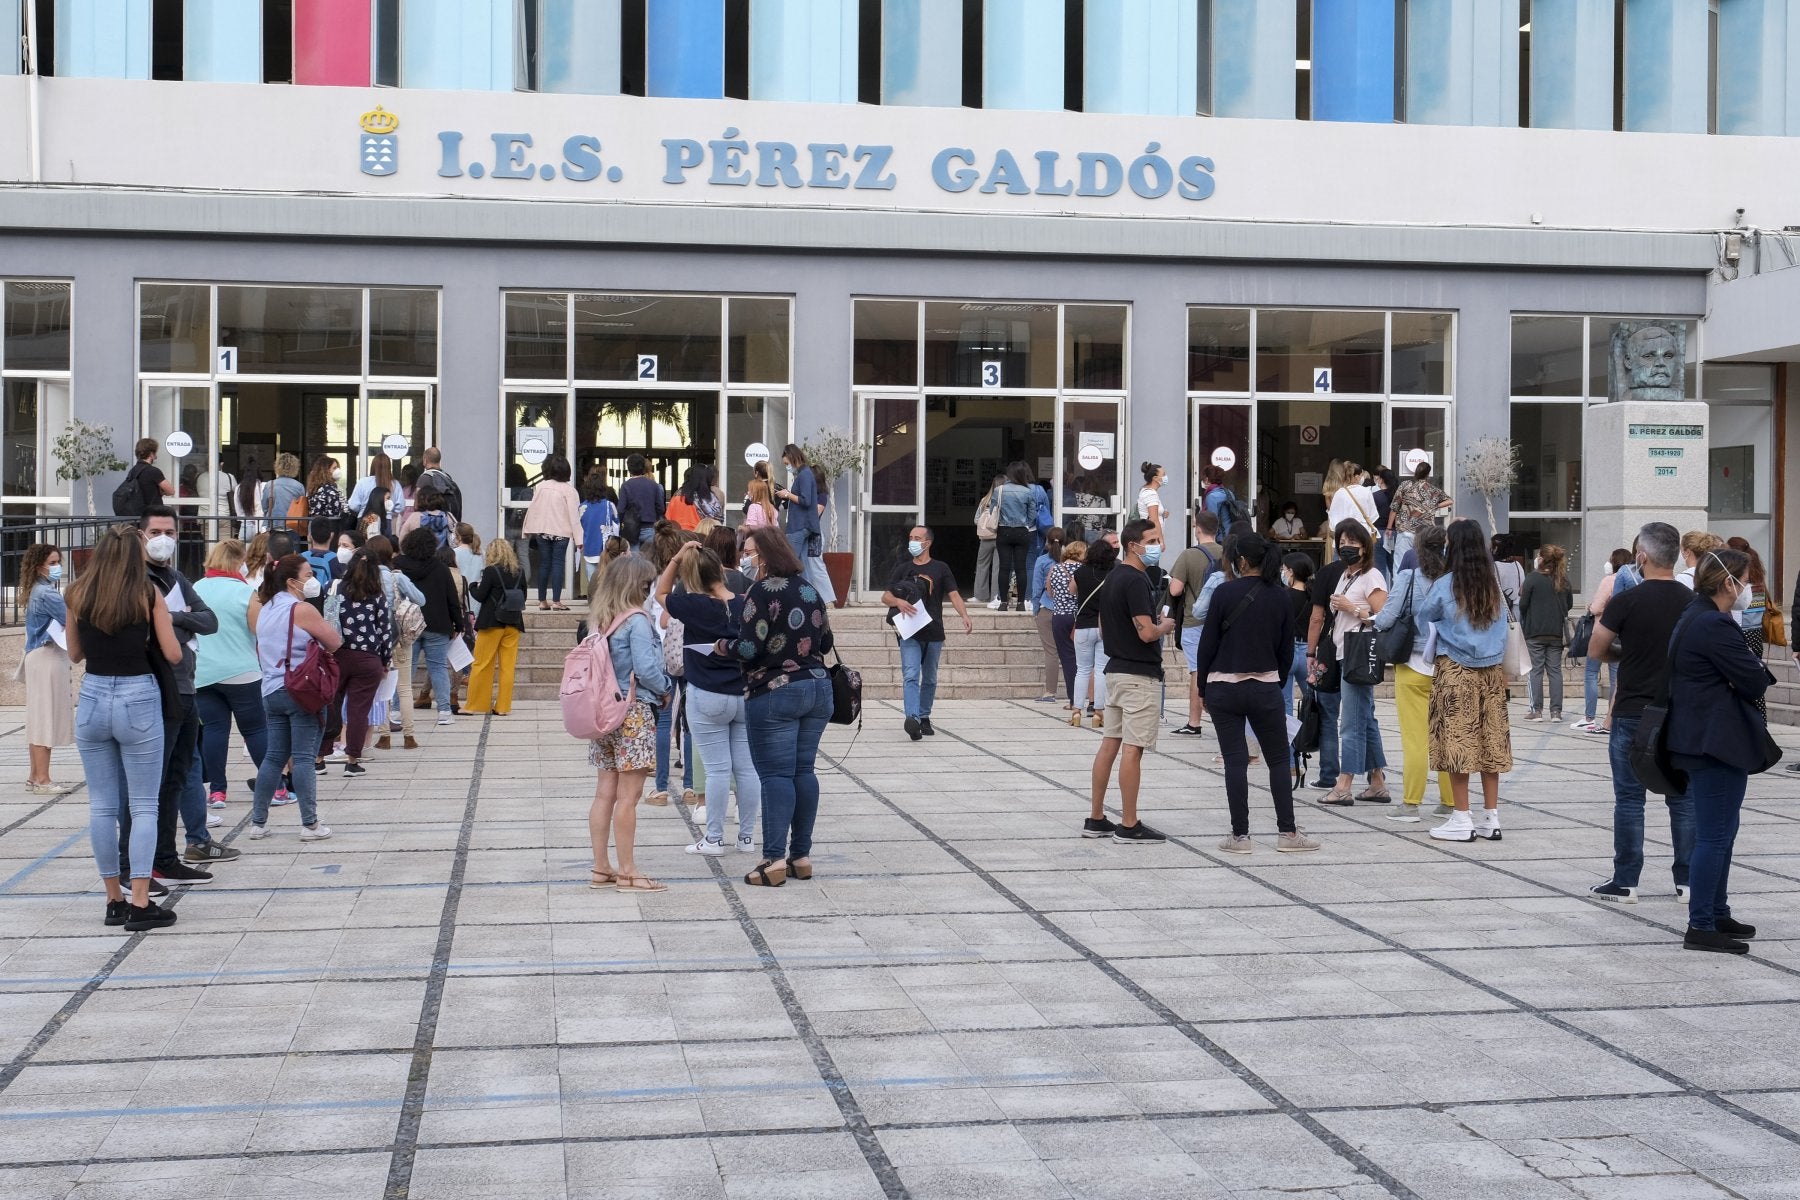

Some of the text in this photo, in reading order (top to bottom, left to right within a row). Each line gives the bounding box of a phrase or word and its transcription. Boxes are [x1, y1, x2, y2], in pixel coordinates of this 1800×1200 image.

[438, 127, 1216, 200] I.E.S. PÉREZ GALDÓS
[221, 350, 231, 371] 1
[639, 357, 655, 379] 2
[983, 364, 999, 386] 3
[1315, 370, 1330, 392] 4
[1657, 468, 1674, 476] 2014
